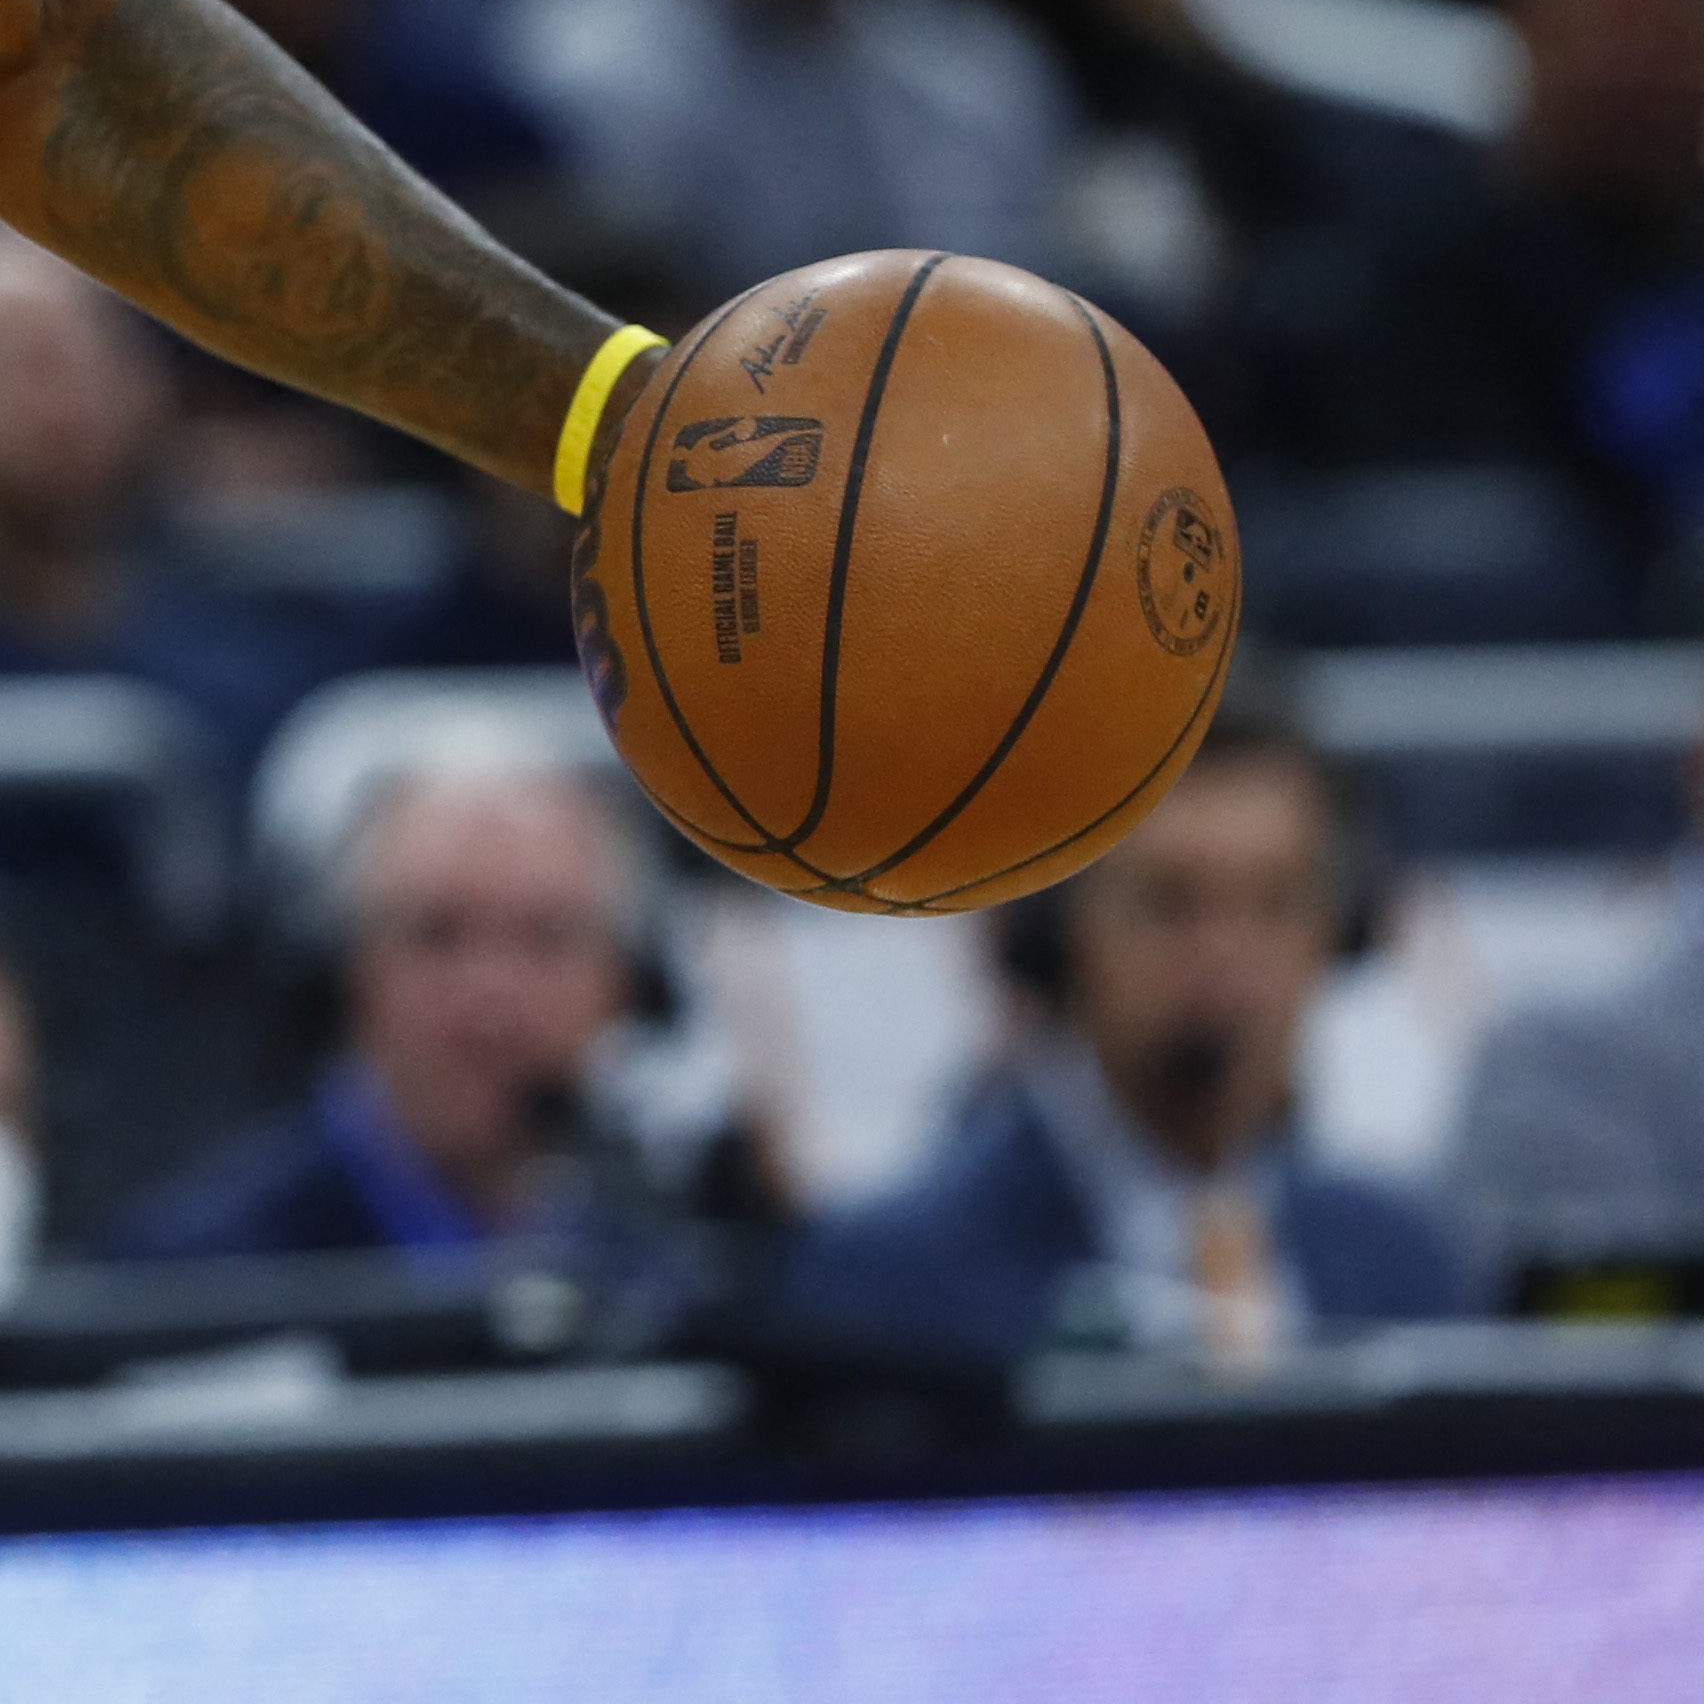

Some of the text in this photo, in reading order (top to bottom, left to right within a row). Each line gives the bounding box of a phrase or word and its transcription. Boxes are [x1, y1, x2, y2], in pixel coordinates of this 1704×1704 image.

[713, 511, 742, 665] OFFICIAL GAME BALL
